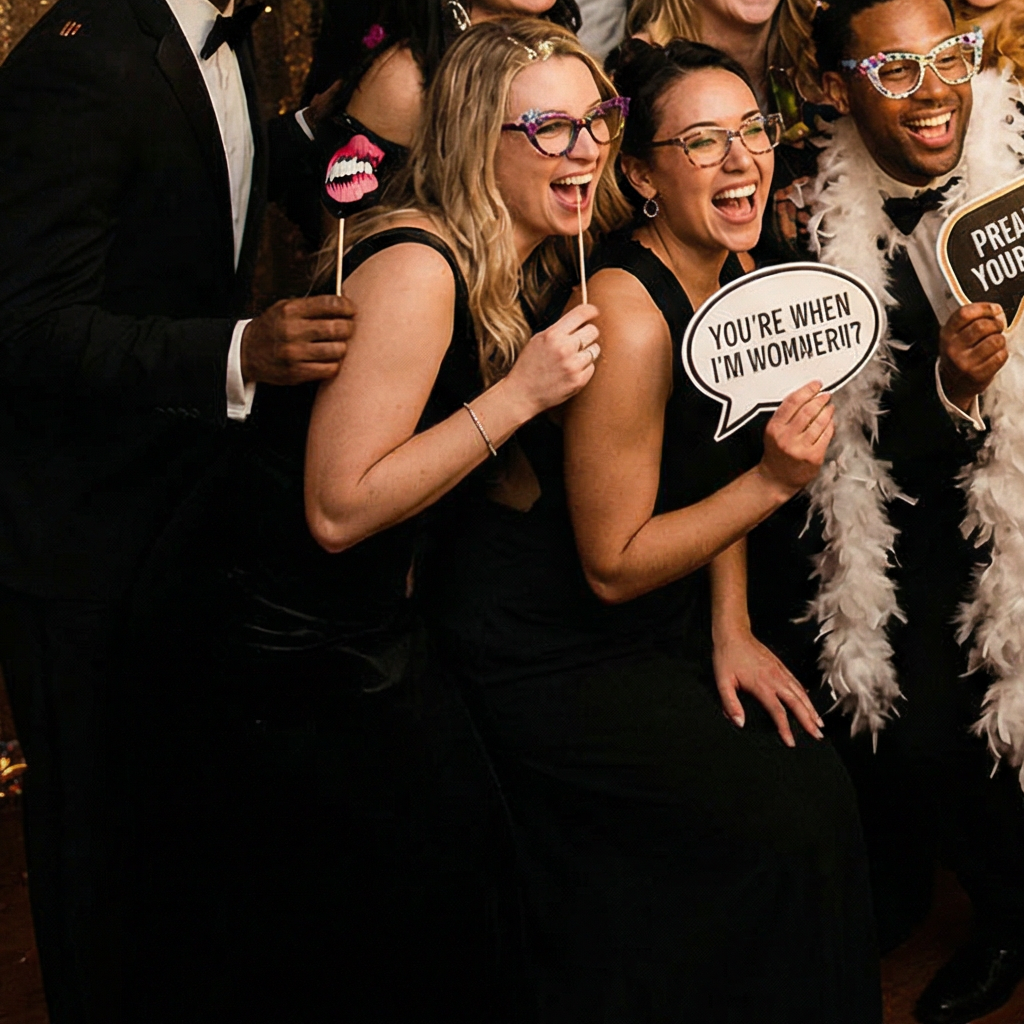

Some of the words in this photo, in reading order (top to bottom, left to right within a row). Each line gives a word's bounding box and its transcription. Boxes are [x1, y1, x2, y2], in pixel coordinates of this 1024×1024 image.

[708, 308, 785, 350] YOU'RE
[789, 292, 851, 329] WHEN
[711, 352, 744, 383] I'M
